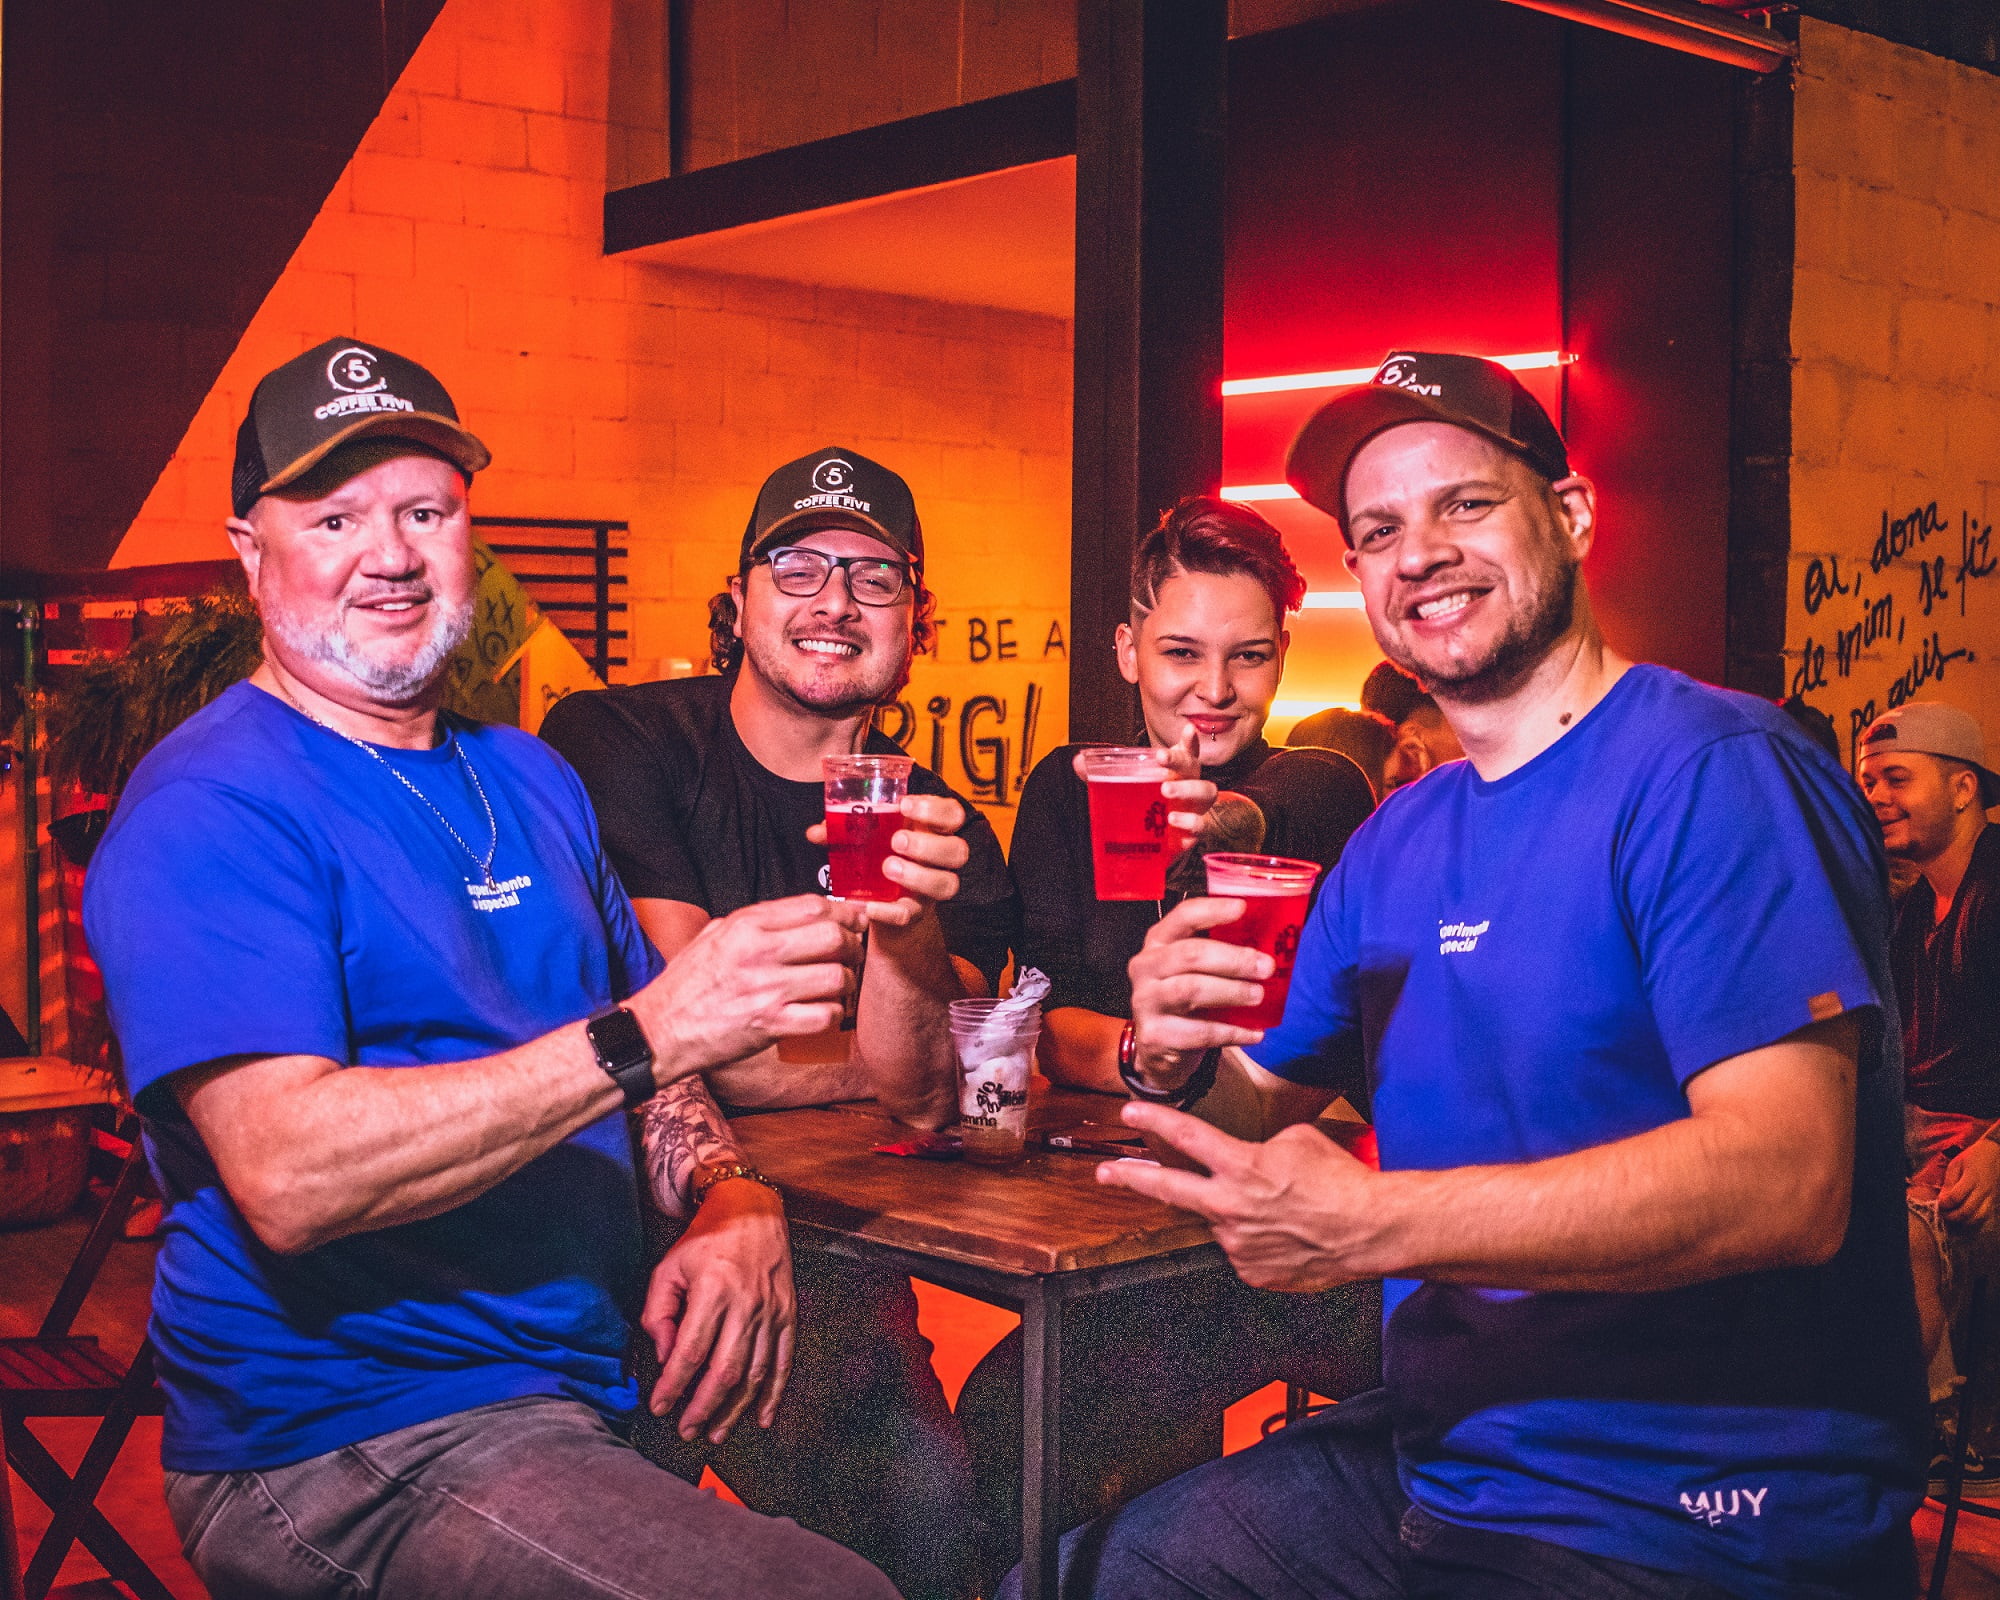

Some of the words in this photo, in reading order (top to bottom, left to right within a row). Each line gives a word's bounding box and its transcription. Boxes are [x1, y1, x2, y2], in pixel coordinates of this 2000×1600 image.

[347, 358, 371, 383] 5
[1381, 365, 1402, 385] 5
[314, 395, 377, 419] COFFEE
[379, 395, 415, 412] FIVE
[825, 467, 843, 485] 5
[793, 495, 840, 510] COFFEE
[843, 496, 871, 512] FIVE
[1870, 501, 1948, 573] dona
[968, 617, 1018, 663] BE
[1043, 619, 1067, 658] A
